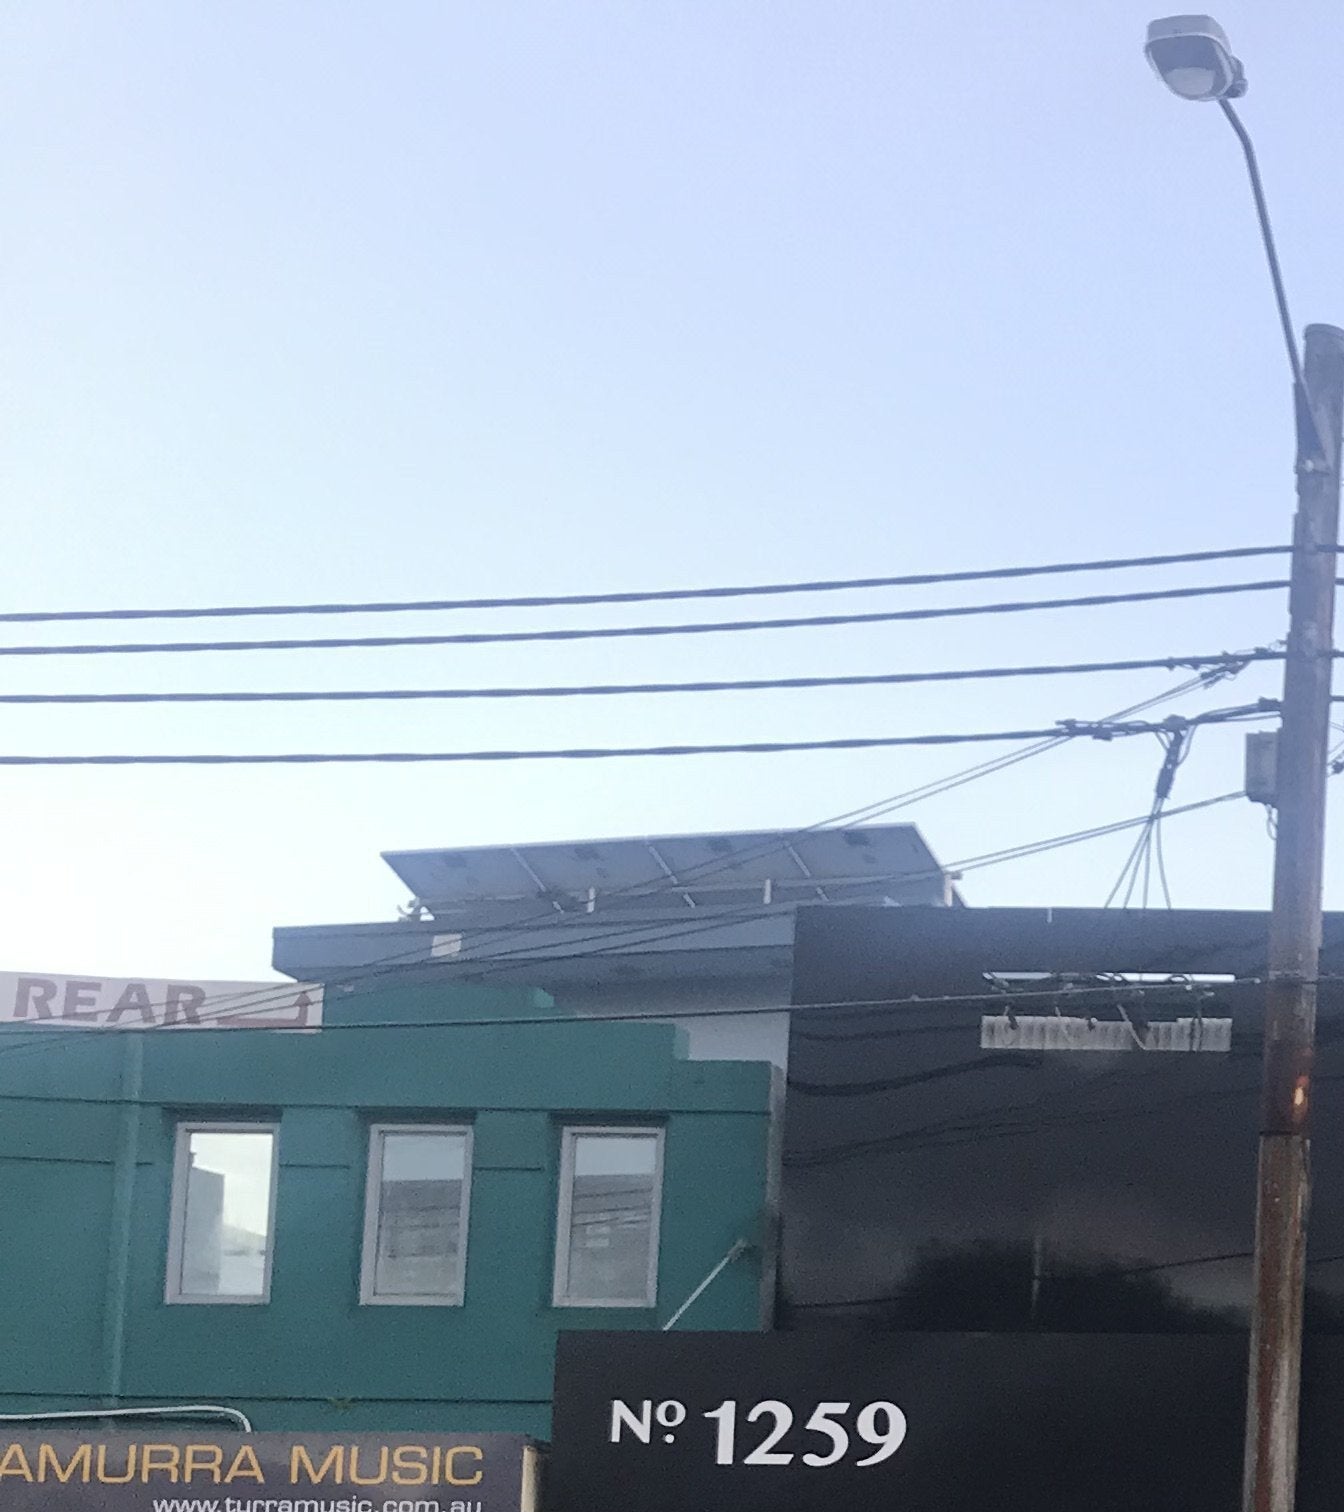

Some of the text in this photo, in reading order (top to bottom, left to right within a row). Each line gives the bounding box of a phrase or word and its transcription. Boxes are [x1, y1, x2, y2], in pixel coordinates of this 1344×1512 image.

[13, 977, 207, 1025] REAR
[703, 1400, 907, 1467] 1259
[289, 1443, 484, 1486] MUSIC
